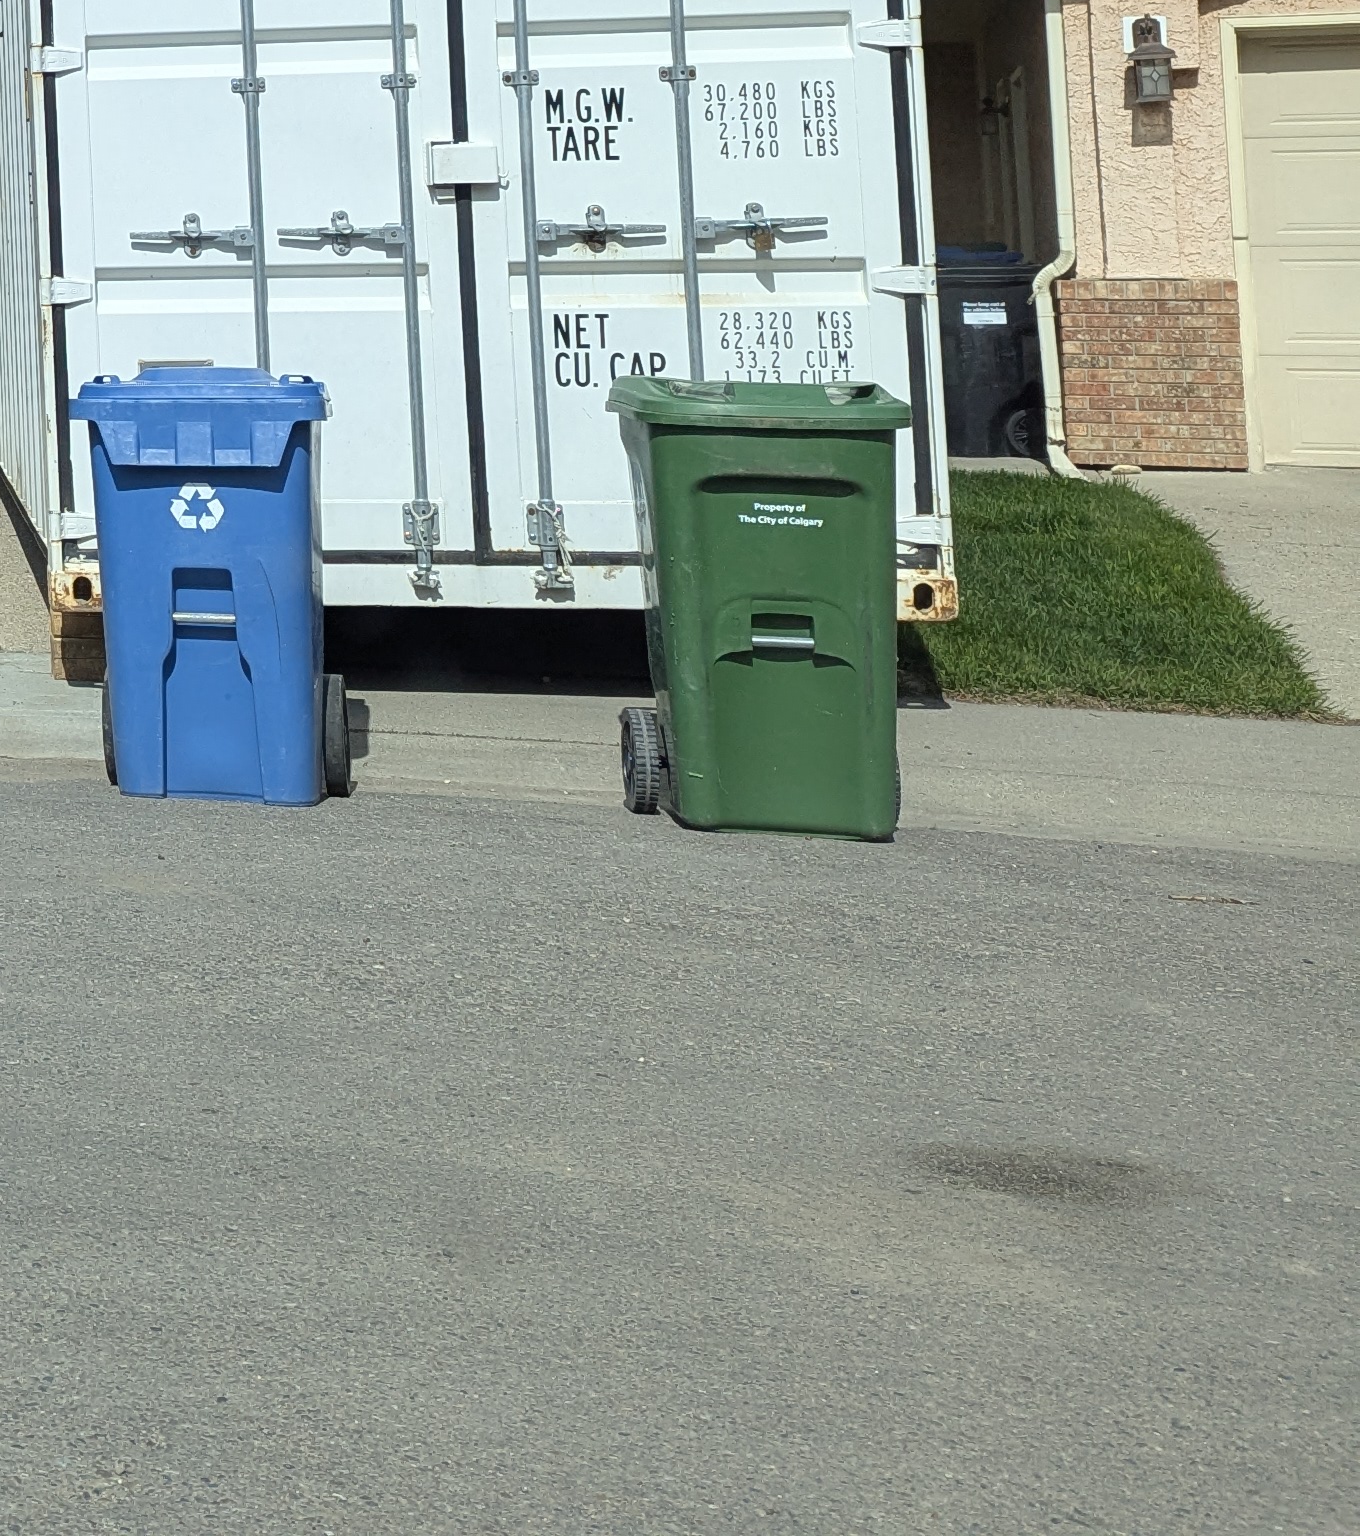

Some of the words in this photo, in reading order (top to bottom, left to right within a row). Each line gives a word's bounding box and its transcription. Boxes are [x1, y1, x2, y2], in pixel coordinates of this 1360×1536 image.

[545, 87, 634, 124] M.G.W.
[800, 80, 835, 100] KGS
[801, 99, 837, 120] LBS
[546, 125, 621, 162] TARE
[803, 119, 838, 138] KGS
[805, 138, 839, 157] LBS
[552, 313, 610, 349] NET
[817, 311, 852, 330] KGS
[818, 331, 853, 350] LBS
[554, 352, 599, 388] CU.
[735, 350, 781, 369] 33.2
[753, 502, 795, 513] Property
[795, 504, 806, 512] of
[738, 514, 757, 524] The
[757, 516, 777, 525] City
[777, 517, 789, 525] of
[789, 517, 824, 527] Calgary
